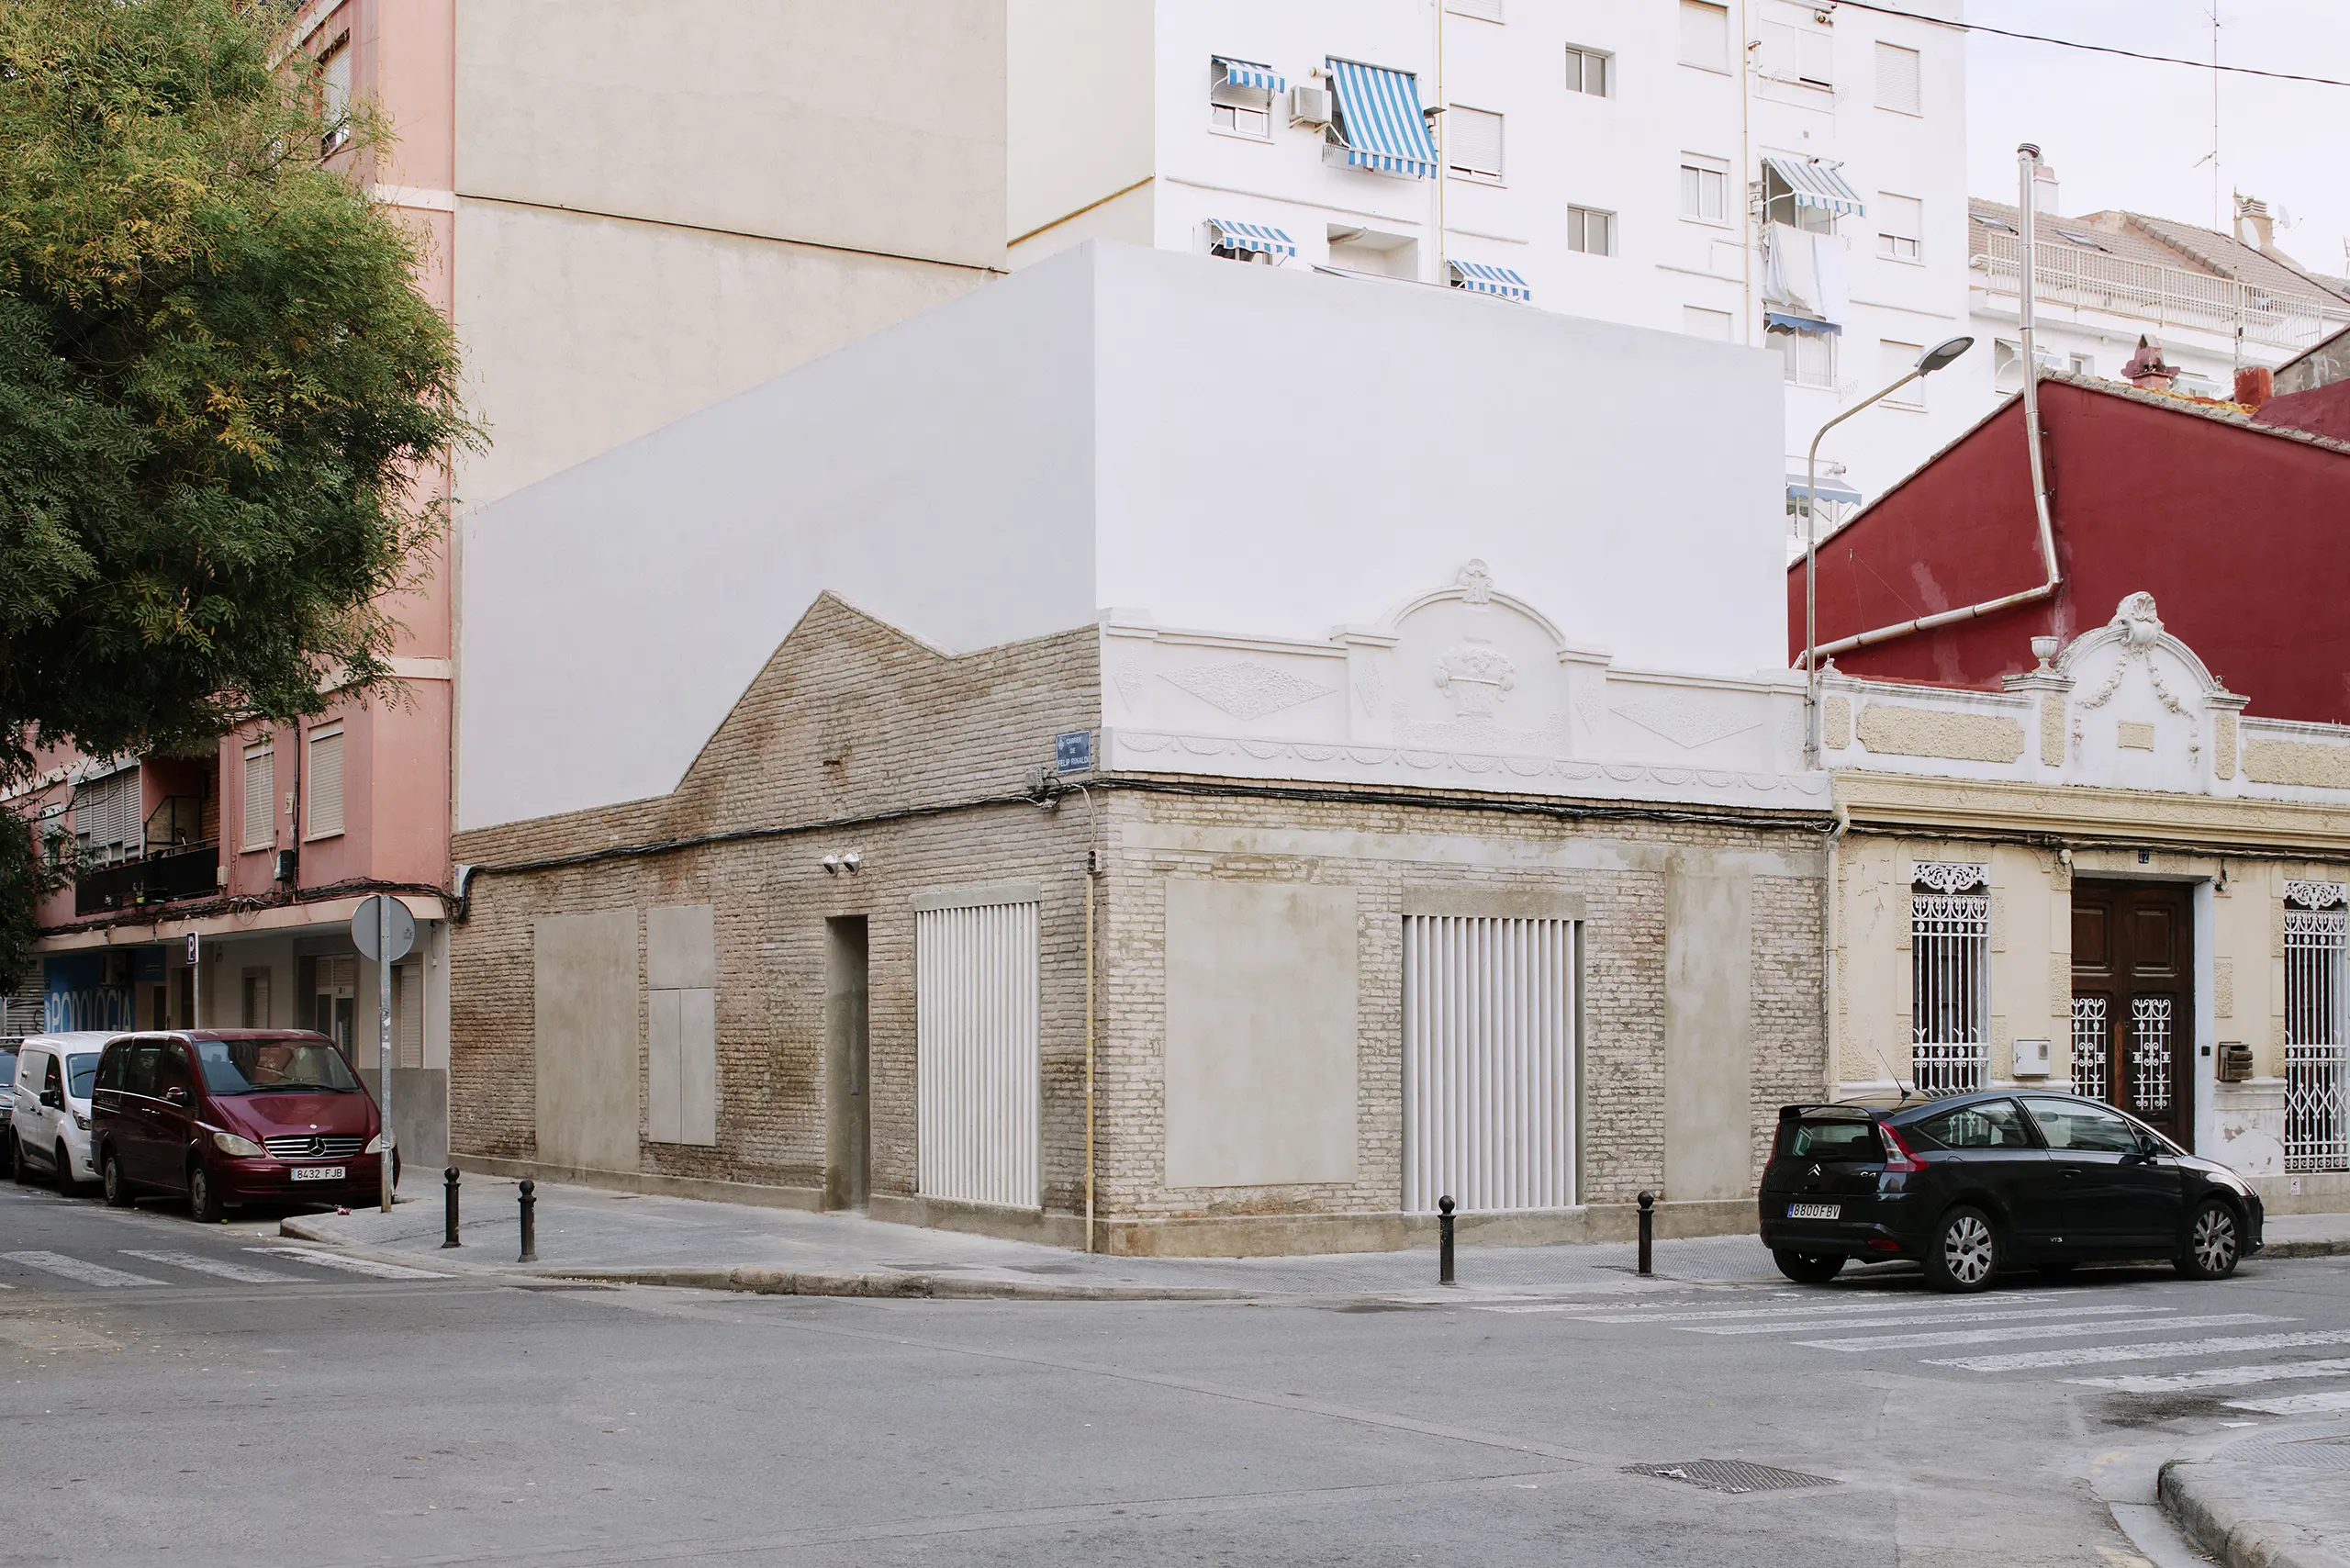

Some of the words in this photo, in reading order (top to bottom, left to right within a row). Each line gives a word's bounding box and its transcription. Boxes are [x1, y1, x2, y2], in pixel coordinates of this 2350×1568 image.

[1058, 758, 1070, 767] FELIP
[297, 1170, 320, 1179] 8432
[325, 1168, 342, 1178] FJB
